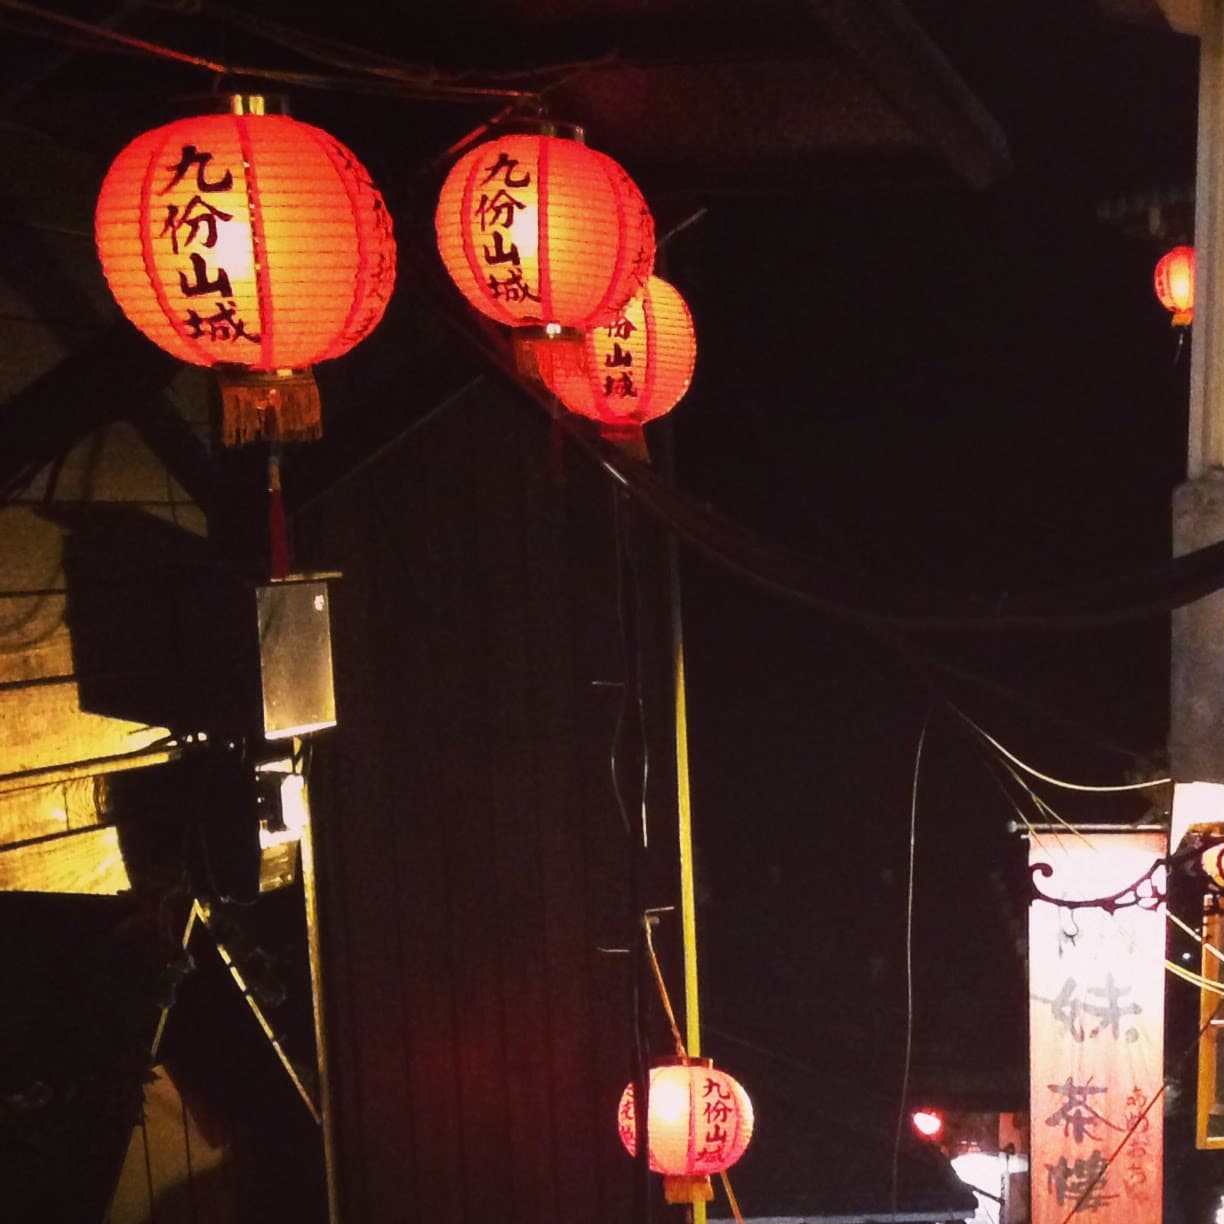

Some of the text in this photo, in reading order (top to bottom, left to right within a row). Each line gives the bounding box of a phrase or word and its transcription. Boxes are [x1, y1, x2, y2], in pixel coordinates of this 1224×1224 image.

[161, 143, 262, 345] 九份山城
[475, 152, 542, 303] 九份山城
